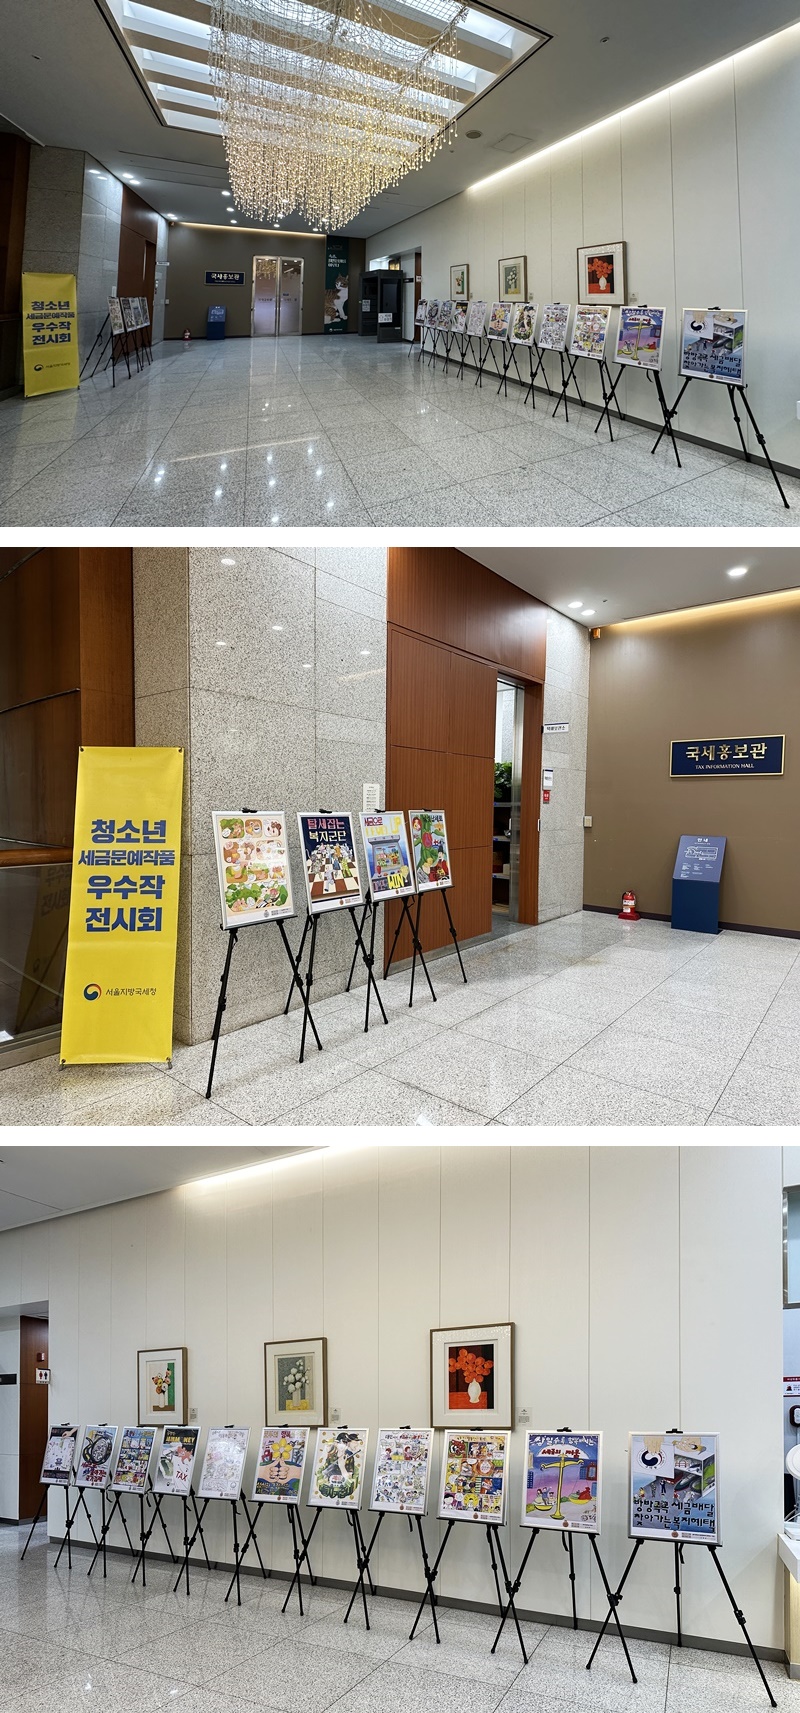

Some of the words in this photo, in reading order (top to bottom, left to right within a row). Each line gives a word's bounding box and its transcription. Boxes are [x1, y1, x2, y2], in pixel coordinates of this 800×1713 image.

[31, 301, 70, 311] 청소년
[26, 312, 75, 320] 세금문예작품
[32, 321, 71, 332] 우수작
[32, 333, 71, 345] 전시회
[685, 742, 767, 761] 국세홍보관
[91, 819, 166, 843] 청소년
[309, 830, 347, 842] 복지군단
[78, 850, 175, 866] 세금문예작품
[87, 875, 165, 900] 우수작
[86, 907, 163, 932] 전시회
[105, 987, 157, 997] 서울지방국세청
[175, 1471, 188, 1481] TAX
[633, 1499, 669, 1513] 방방곡곡
[671, 1501, 715, 1517] 세금배달
[634, 1513, 671, 1529] 찾아가는
[673, 1516, 715, 1533] 복지혜택
